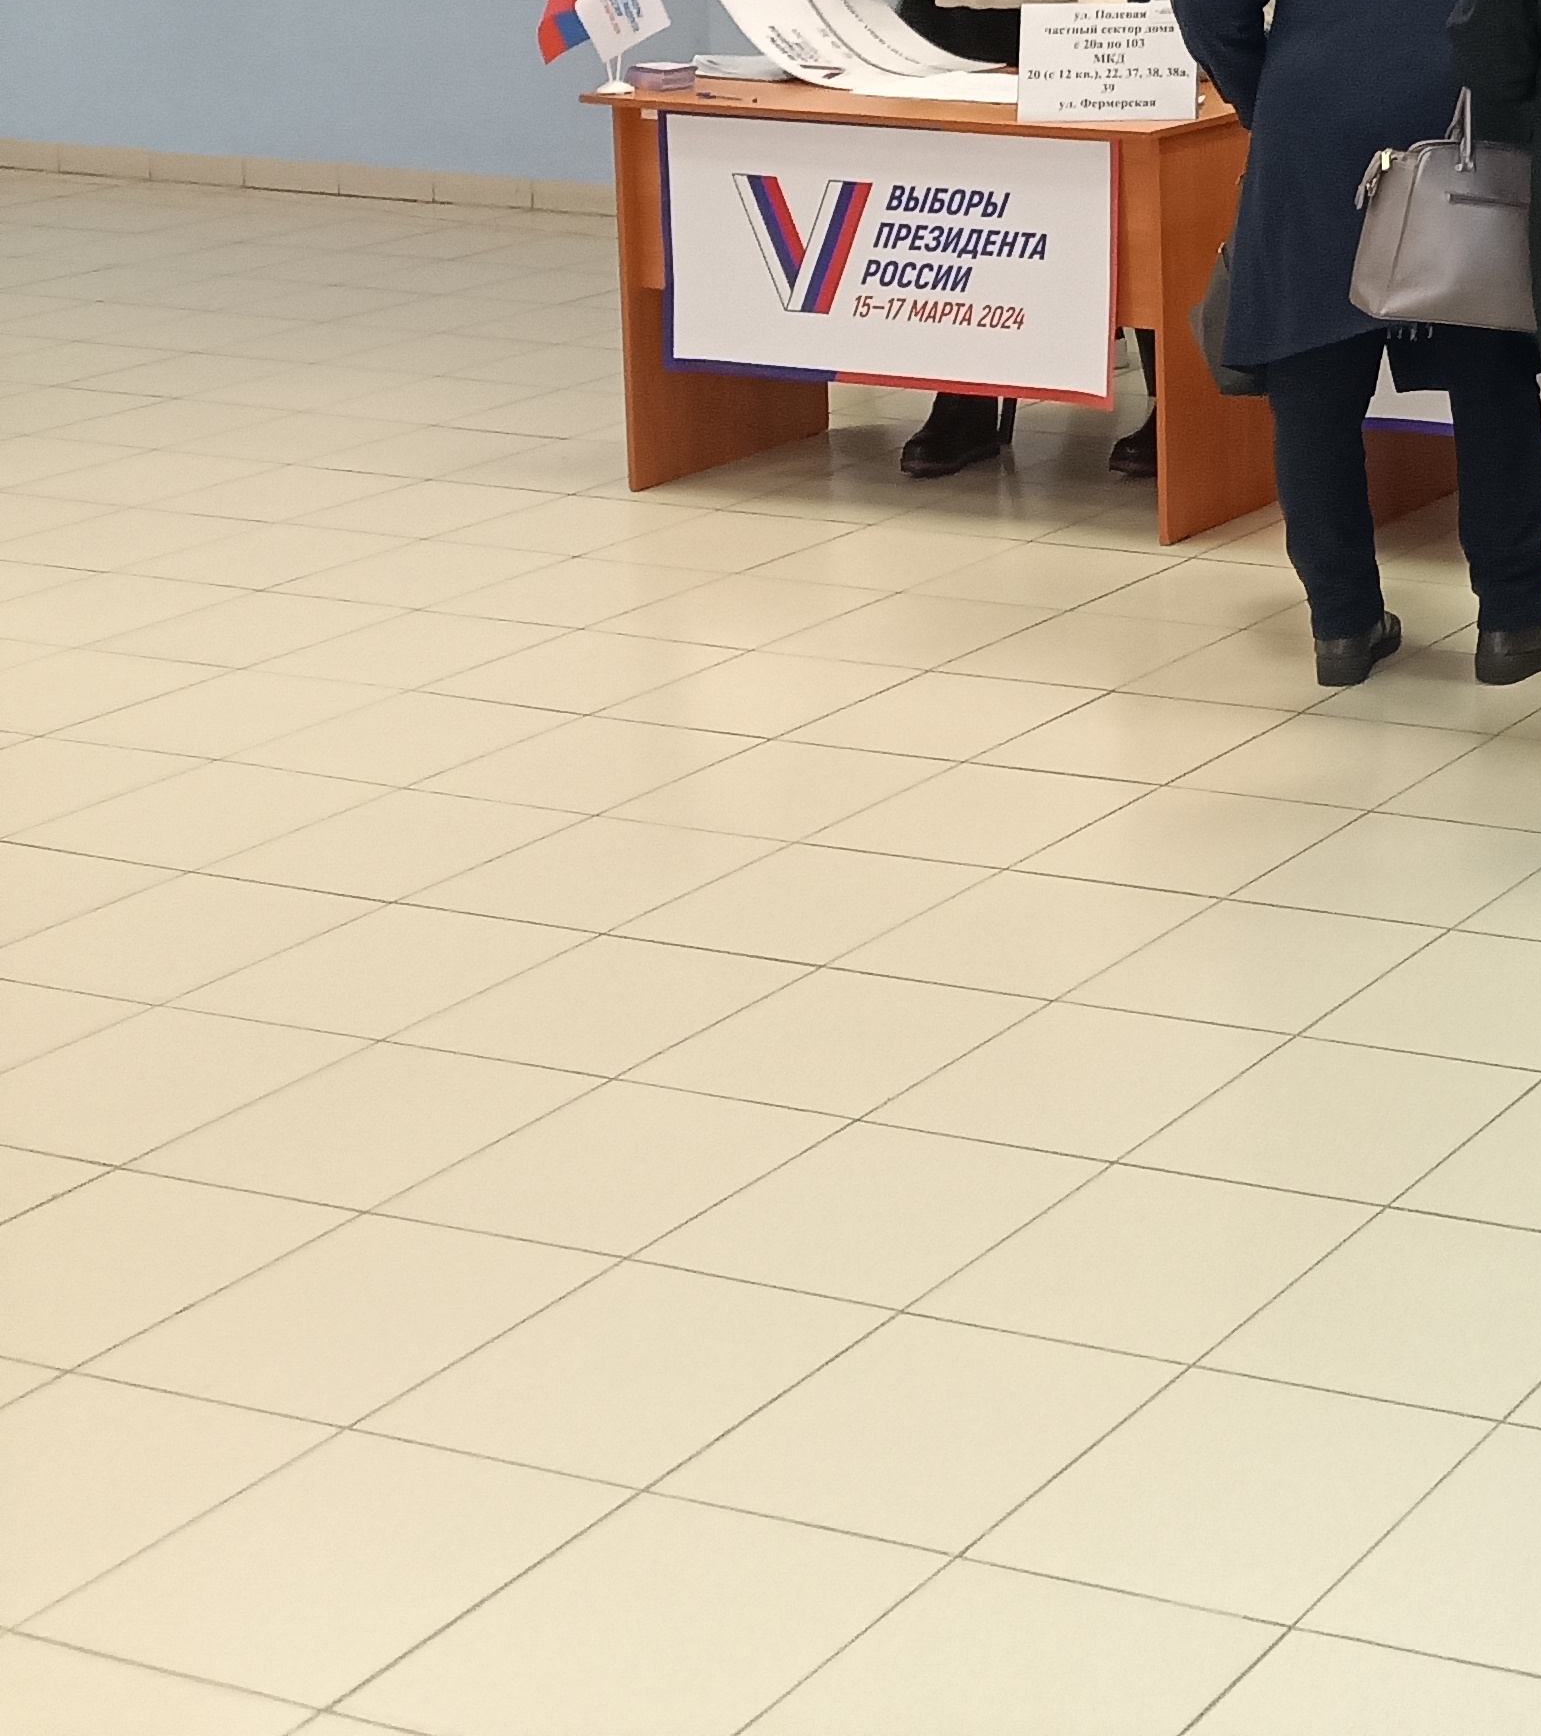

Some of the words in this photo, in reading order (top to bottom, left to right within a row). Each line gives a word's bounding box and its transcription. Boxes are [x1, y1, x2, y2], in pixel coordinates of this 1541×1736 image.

[1101, 25, 1142, 35] сектор
[1125, 39, 1145, 48] 103
[1027, 69, 1040, 79] 20
[1059, 69, 1071, 79] 12
[1101, 83, 1115, 94] 39
[885, 184, 1011, 219] ВЫБОРЫ
[872, 222, 1048, 261] ПРЕЗИДЕНТА
[860, 259, 973, 293] РОССИИ
[907, 299, 974, 326] МАРТА
[976, 304, 1025, 330] 2024
